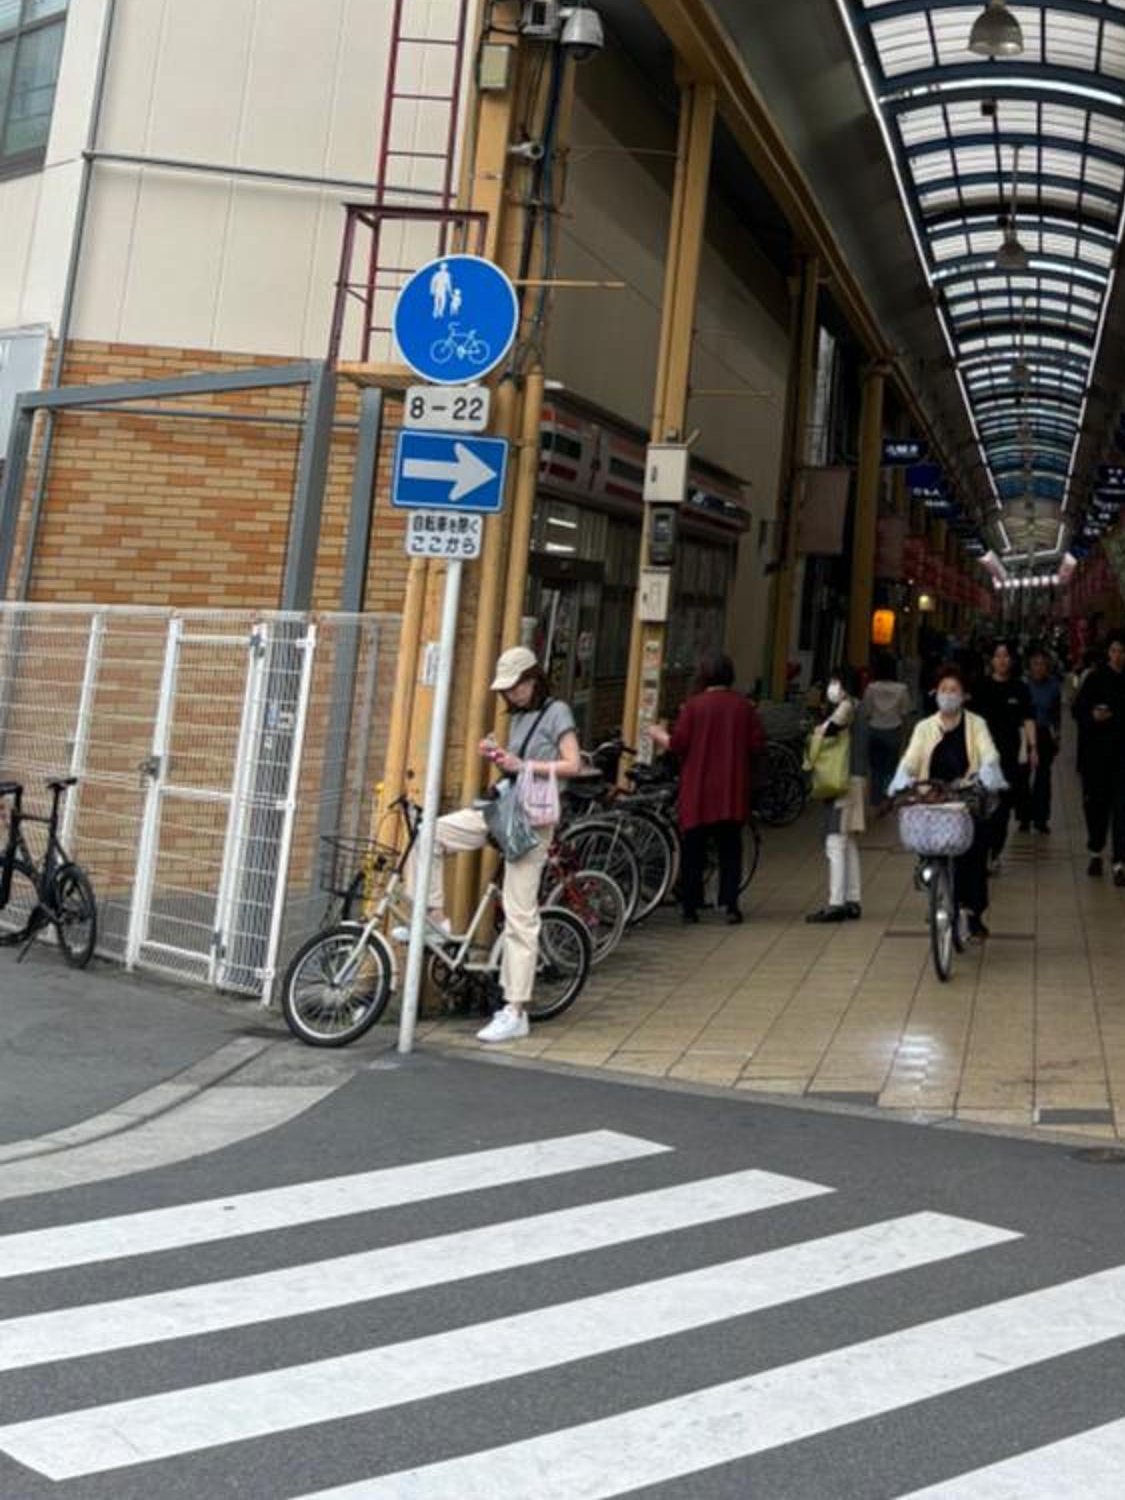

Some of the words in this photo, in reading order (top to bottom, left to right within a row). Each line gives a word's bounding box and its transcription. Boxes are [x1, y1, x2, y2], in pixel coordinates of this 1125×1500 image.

[413, 515, 479, 534] 自転車を除く
[411, 535, 476, 554] ここから
